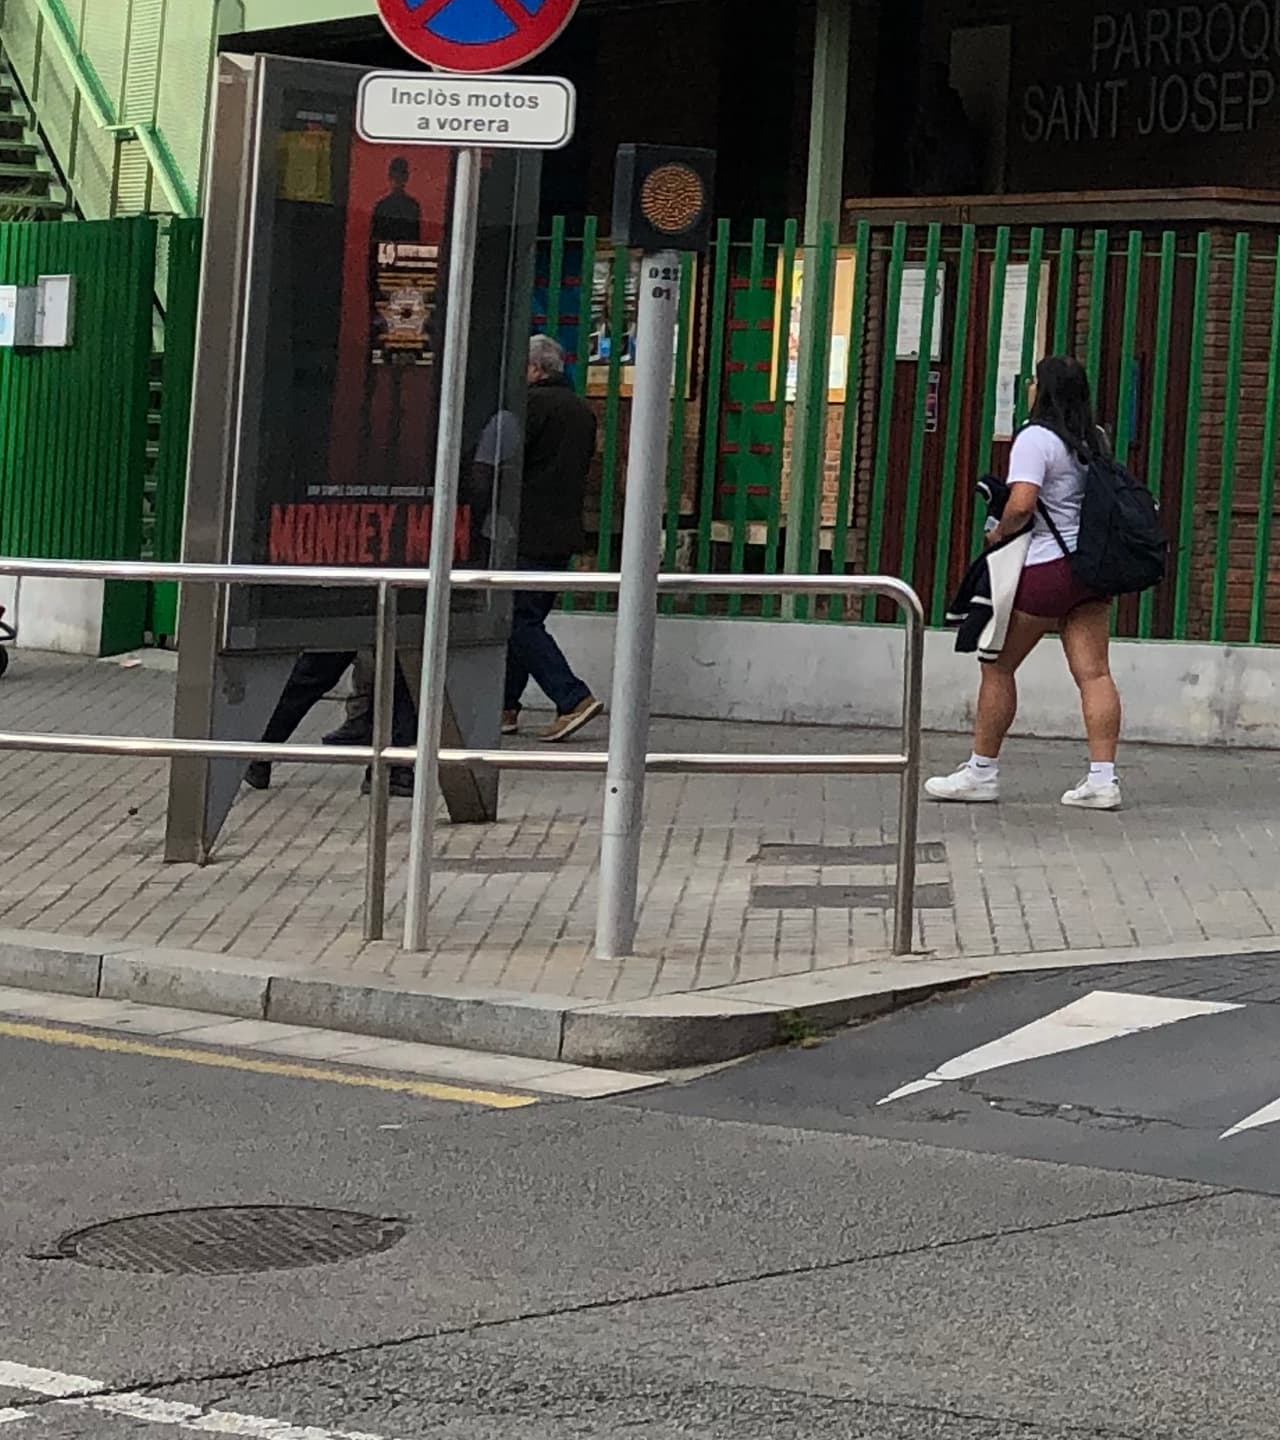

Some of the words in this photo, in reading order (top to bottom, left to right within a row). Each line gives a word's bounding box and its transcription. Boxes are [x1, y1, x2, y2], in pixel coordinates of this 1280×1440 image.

[391, 87, 461, 106] Inclòs
[467, 92, 539, 109] motos
[1021, 79, 1128, 143] SANT
[1137, 70, 1275, 136] JOSEP
[417, 116, 430, 130] a
[436, 117, 510, 133] vorera
[269, 503, 397, 563] MONKEY
[405, 503, 471, 563] MN
